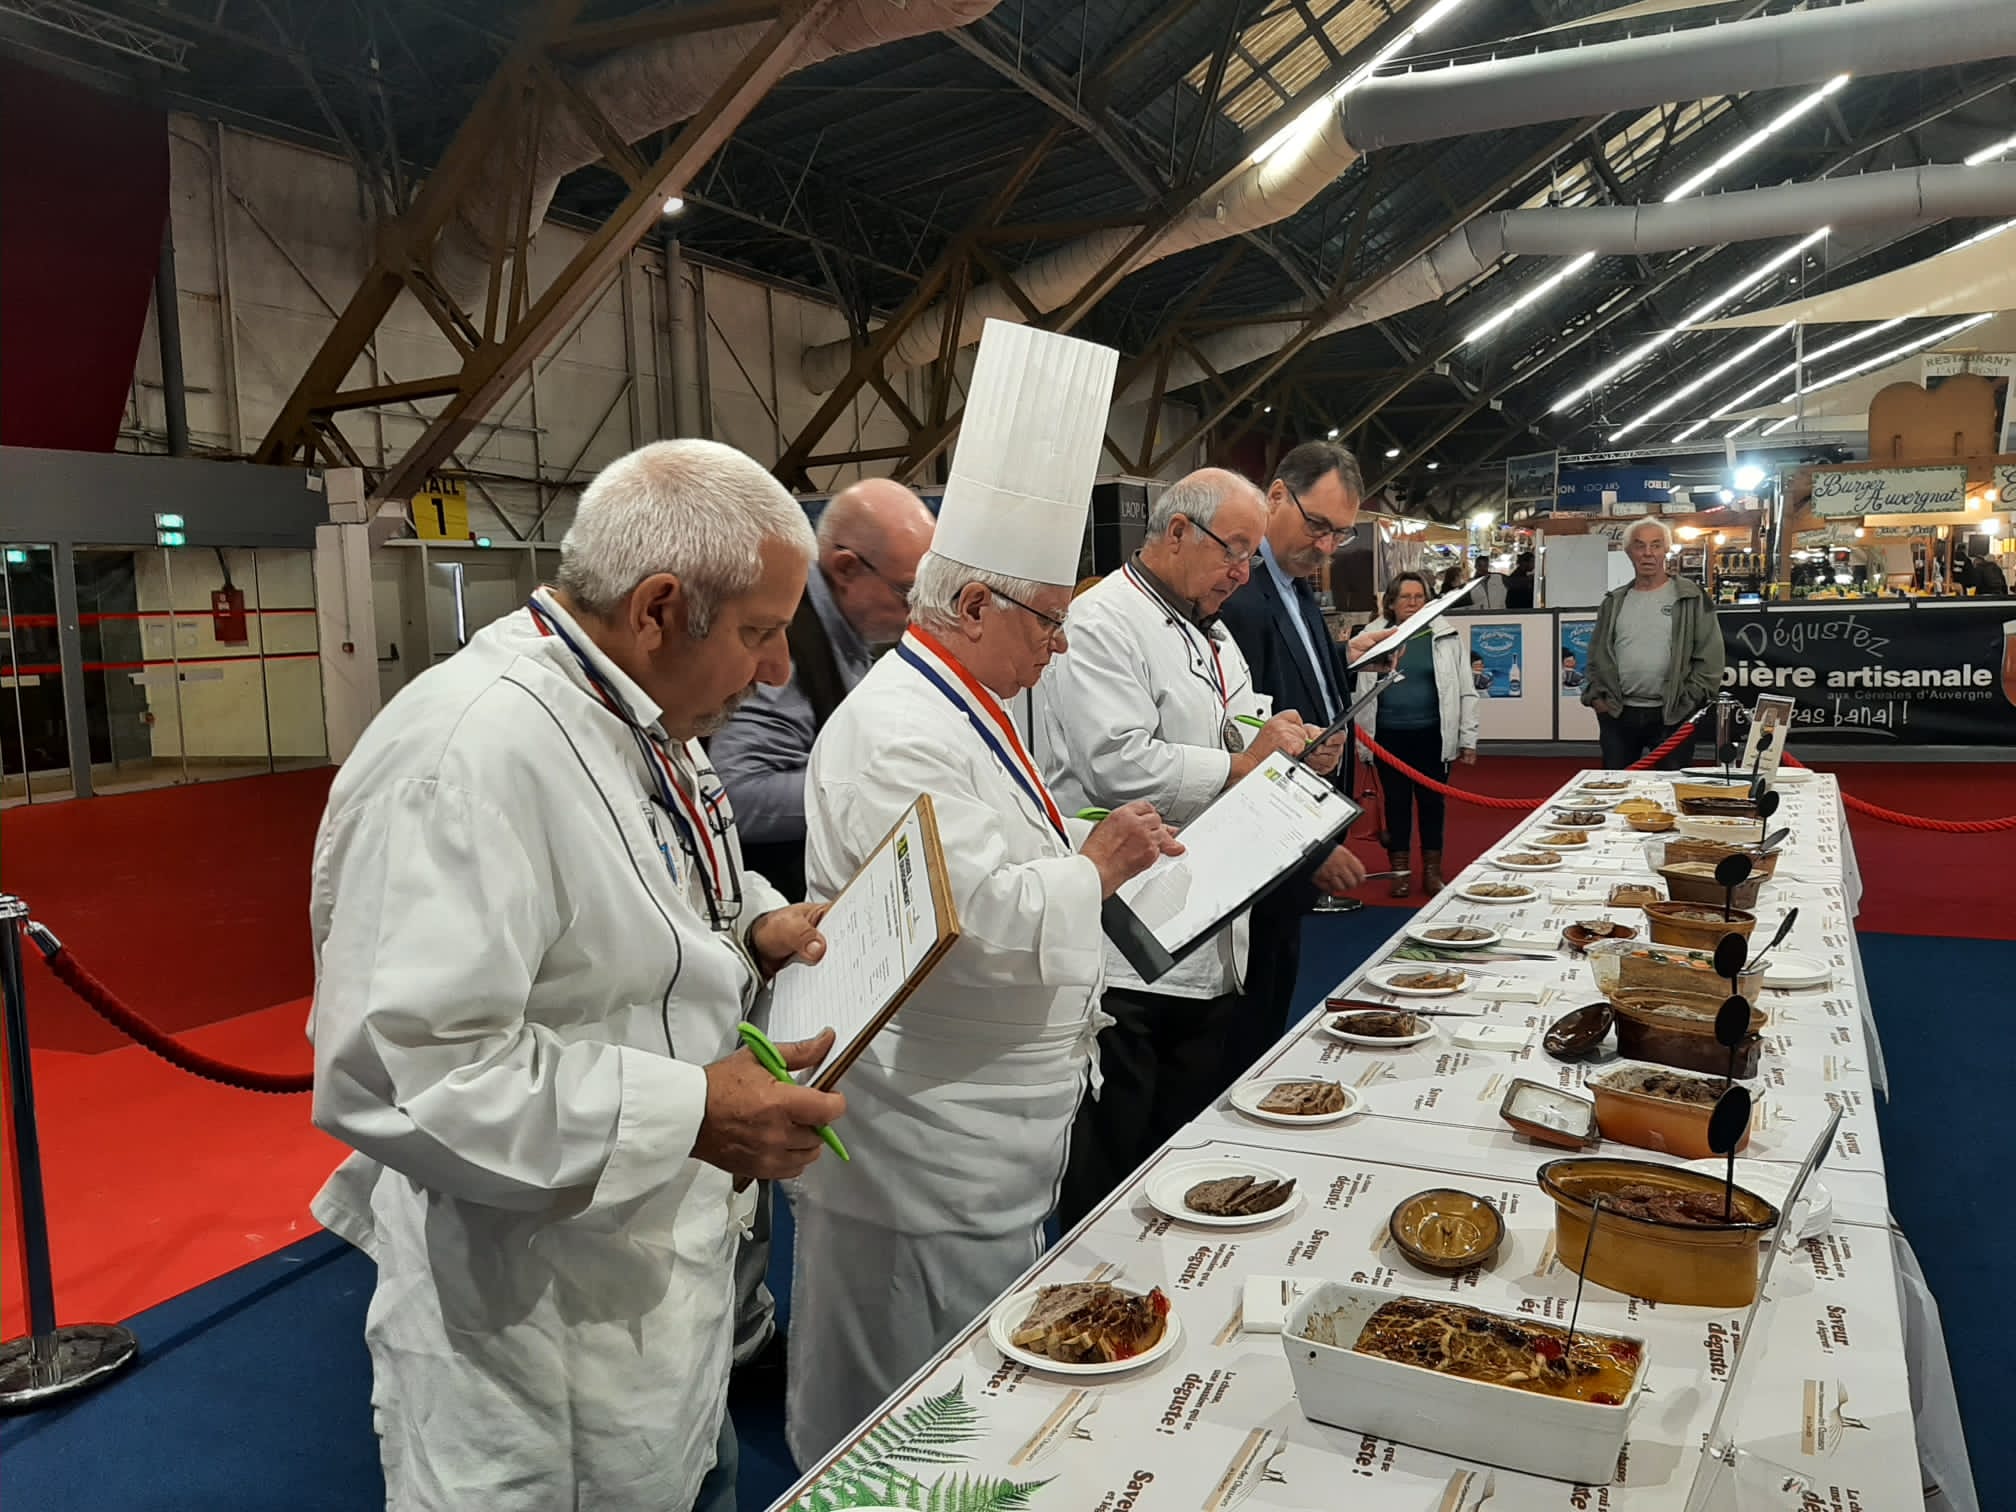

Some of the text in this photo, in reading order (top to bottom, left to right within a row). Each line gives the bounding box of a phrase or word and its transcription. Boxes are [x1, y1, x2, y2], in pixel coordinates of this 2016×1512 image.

[1814, 473, 1886, 501] Burger
[1854, 487, 1961, 513] Auvergnat
[431, 498, 447, 535] 1
[1736, 615, 1890, 658] Dégustez
[1827, 663, 1993, 688] artisanale
[1917, 690, 1993, 701] d'Auvergne
[1834, 698, 1893, 728] banal
[1302, 1229, 1329, 1260] Saveur
[1178, 1246, 1212, 1284] déguste
[1826, 1305, 1849, 1346] Saveur
[1704, 1322, 1728, 1375] déguste
[1161, 1373, 1203, 1426] déguste
